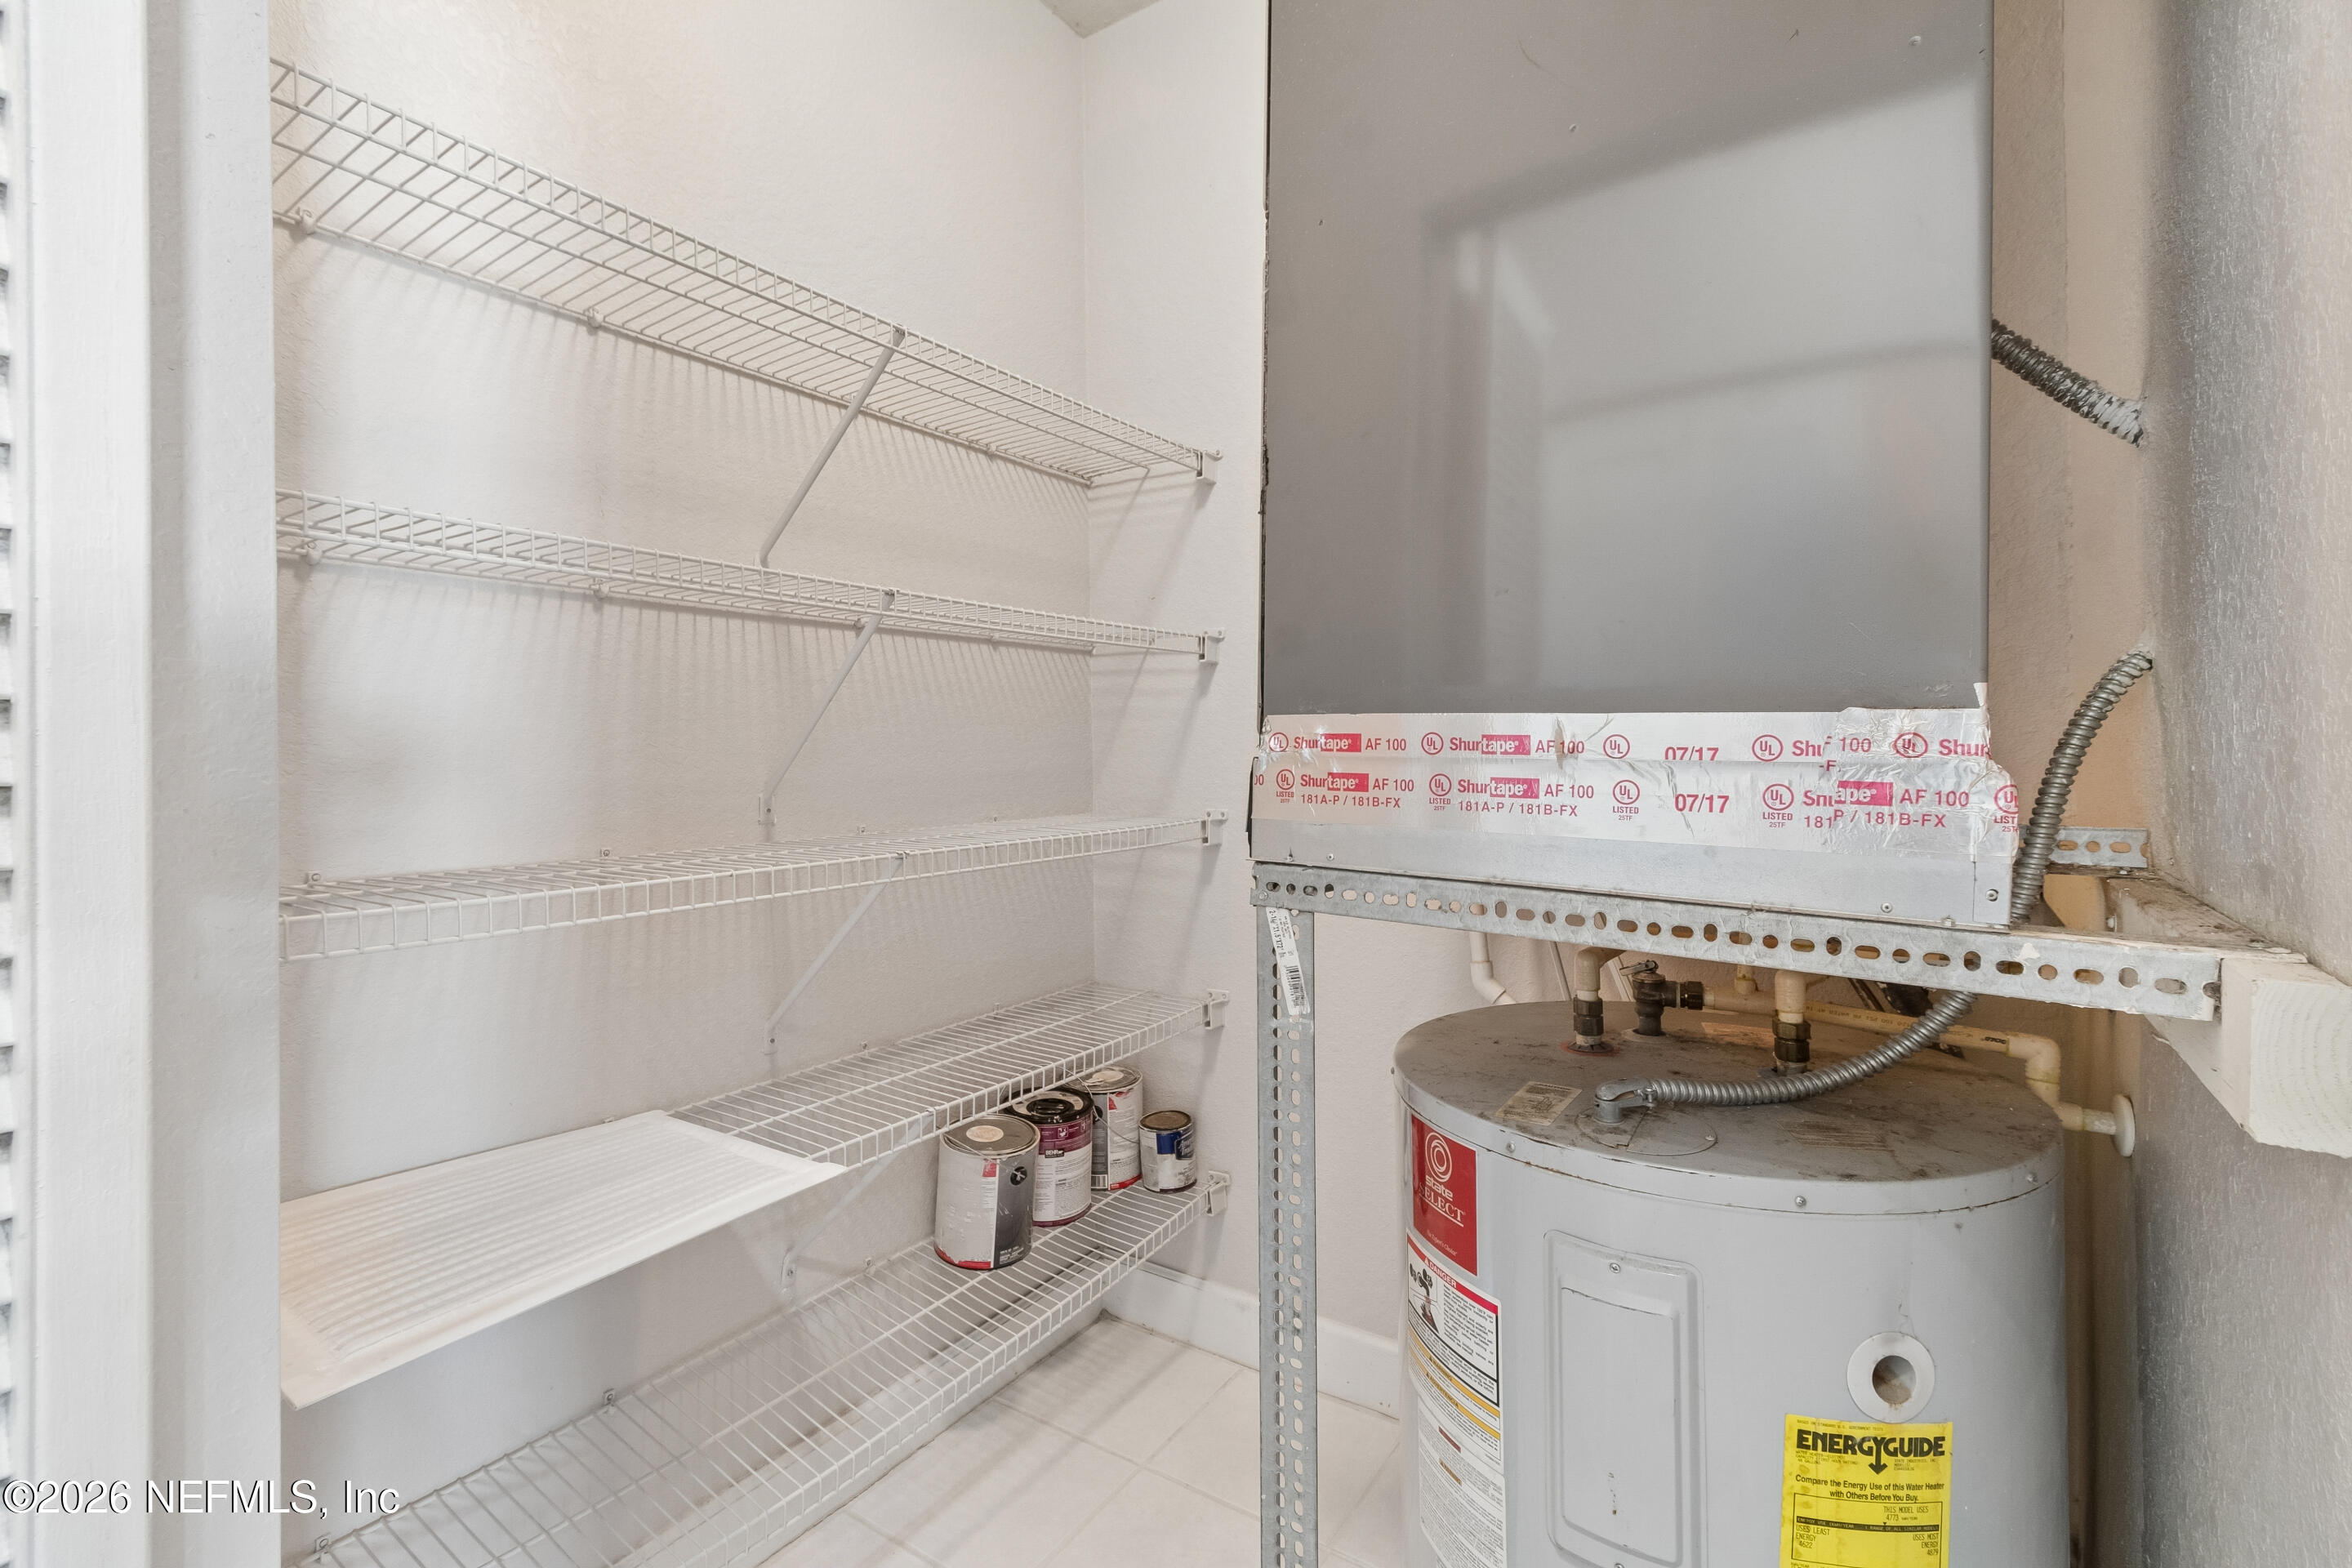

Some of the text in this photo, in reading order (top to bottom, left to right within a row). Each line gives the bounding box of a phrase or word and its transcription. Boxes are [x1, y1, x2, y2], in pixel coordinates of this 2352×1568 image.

[1365, 738, 1382, 750] AF
[1386, 738, 1406, 751] 100
[1535, 740, 1555, 753] AF
[1561, 741, 1584, 754] 100
[1840, 737, 1872, 752] 100
[1664, 746, 1719, 760] 07/17
[1372, 778, 1389, 791] AF
[1393, 779, 1414, 791] 100
[1544, 784, 1564, 797] AF
[1569, 785, 1594, 798] 100
[1301, 794, 1401, 808] 181A-P / 181B-FX
[1675, 793, 1730, 813] 07/17
[1900, 789, 1927, 804] AF
[1935, 791, 1969, 806] 100
[1459, 800, 1578, 817] 181A-P / 181B-FX
[1613, 806, 1638, 814] LISTED
[1762, 812, 1793, 821] LISTED
[1851, 810, 1858, 822] /
[1865, 813, 1946, 828] 181B-FX
[1426, 1174, 1453, 1201] state
[1419, 1182, 1464, 1223] SELECT
[1429, 1262, 1457, 1289] DANGER
[1797, 1429, 1945, 1458] ENERGYGUIDE
[1796, 1474, 1829, 1486] Compare
[1843, 1481, 1867, 1491] Energy
[1846, 1491, 1869, 1499] Others
[1906, 1494, 1918, 1503] Buy.
[1797, 1525, 1811, 1533] USES
[1796, 1533, 1816, 1542] ENERGY
[1799, 1540, 1813, 1549] 4622
